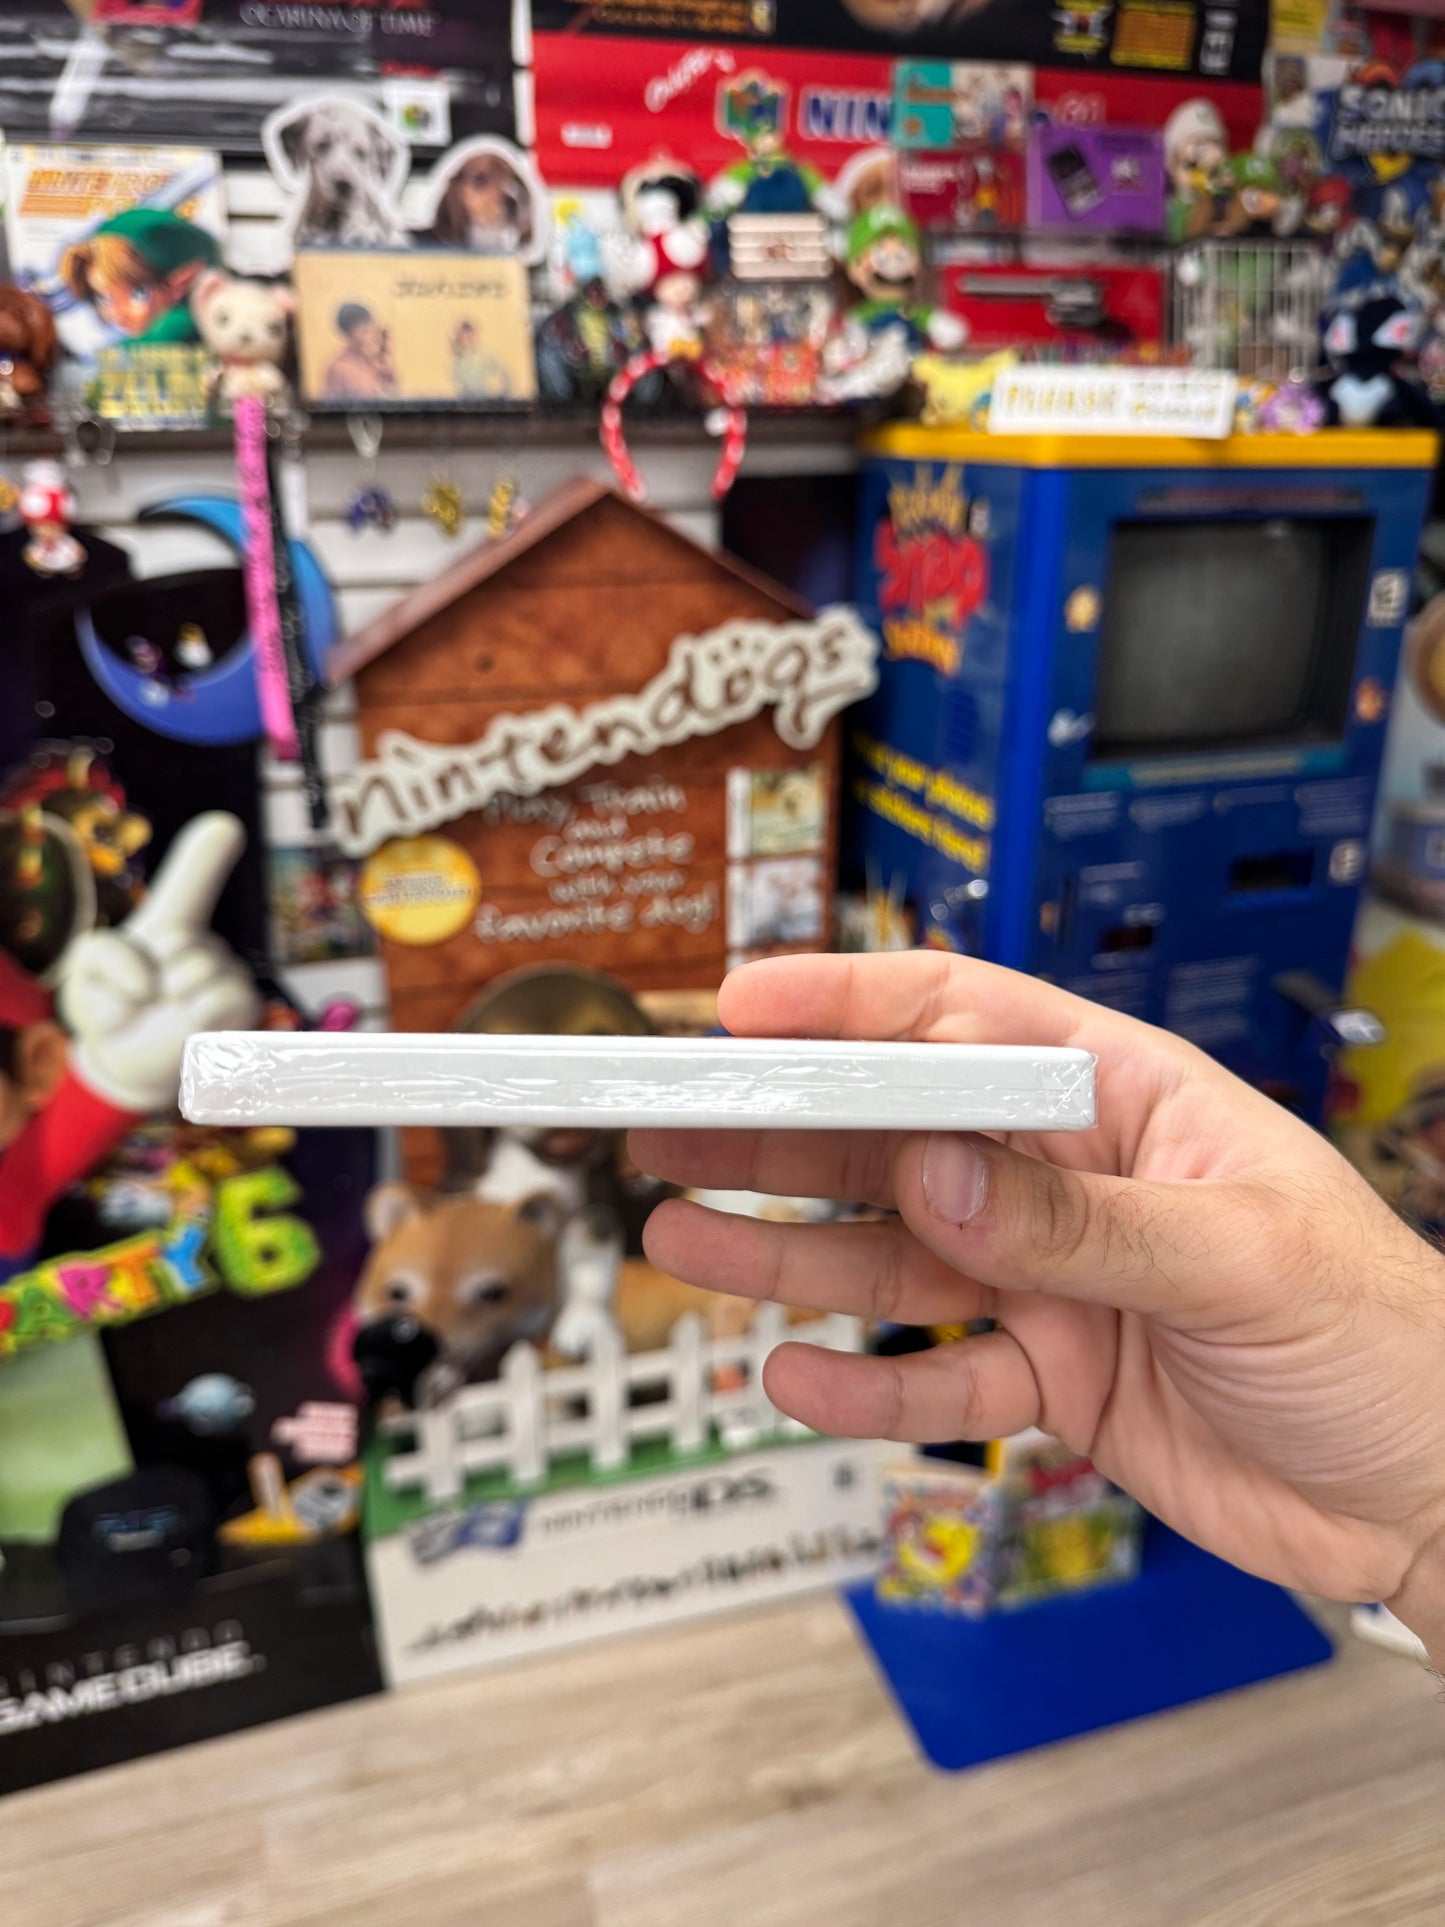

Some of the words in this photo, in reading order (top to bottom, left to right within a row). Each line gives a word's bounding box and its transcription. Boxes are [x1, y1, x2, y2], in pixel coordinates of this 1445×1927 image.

[802, 89, 895, 140] NIN
[533, 831, 693, 875] Compete
[622, 869, 685, 902] your
[218, 1166, 322, 1299] 6
[0, 1621, 242, 1695] INTENDO
[0, 1641, 249, 1732] GAMECUBE
